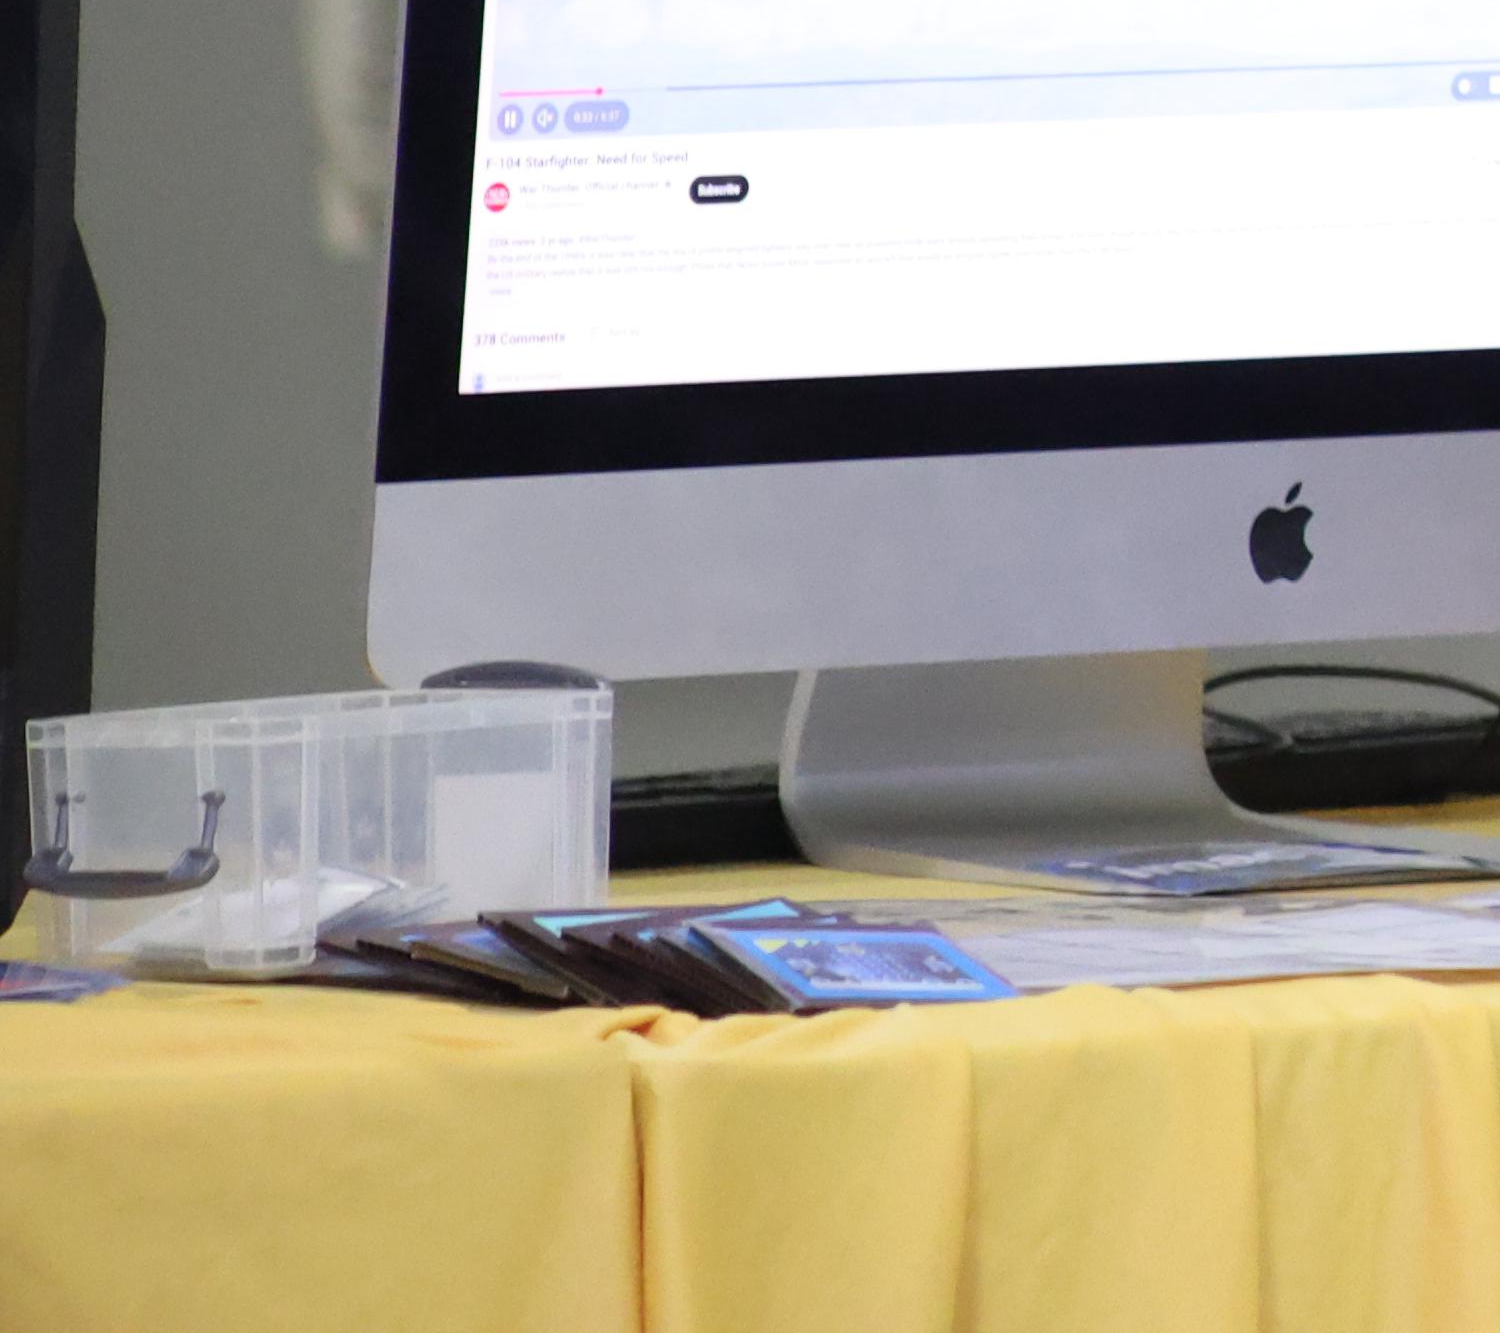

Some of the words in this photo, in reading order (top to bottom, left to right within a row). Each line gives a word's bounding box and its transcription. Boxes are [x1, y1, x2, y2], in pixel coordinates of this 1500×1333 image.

[597, 153, 627, 165] Need
[631, 152, 648, 164] for
[652, 151, 689, 166] Speed
[500, 331, 566, 346] Comments
